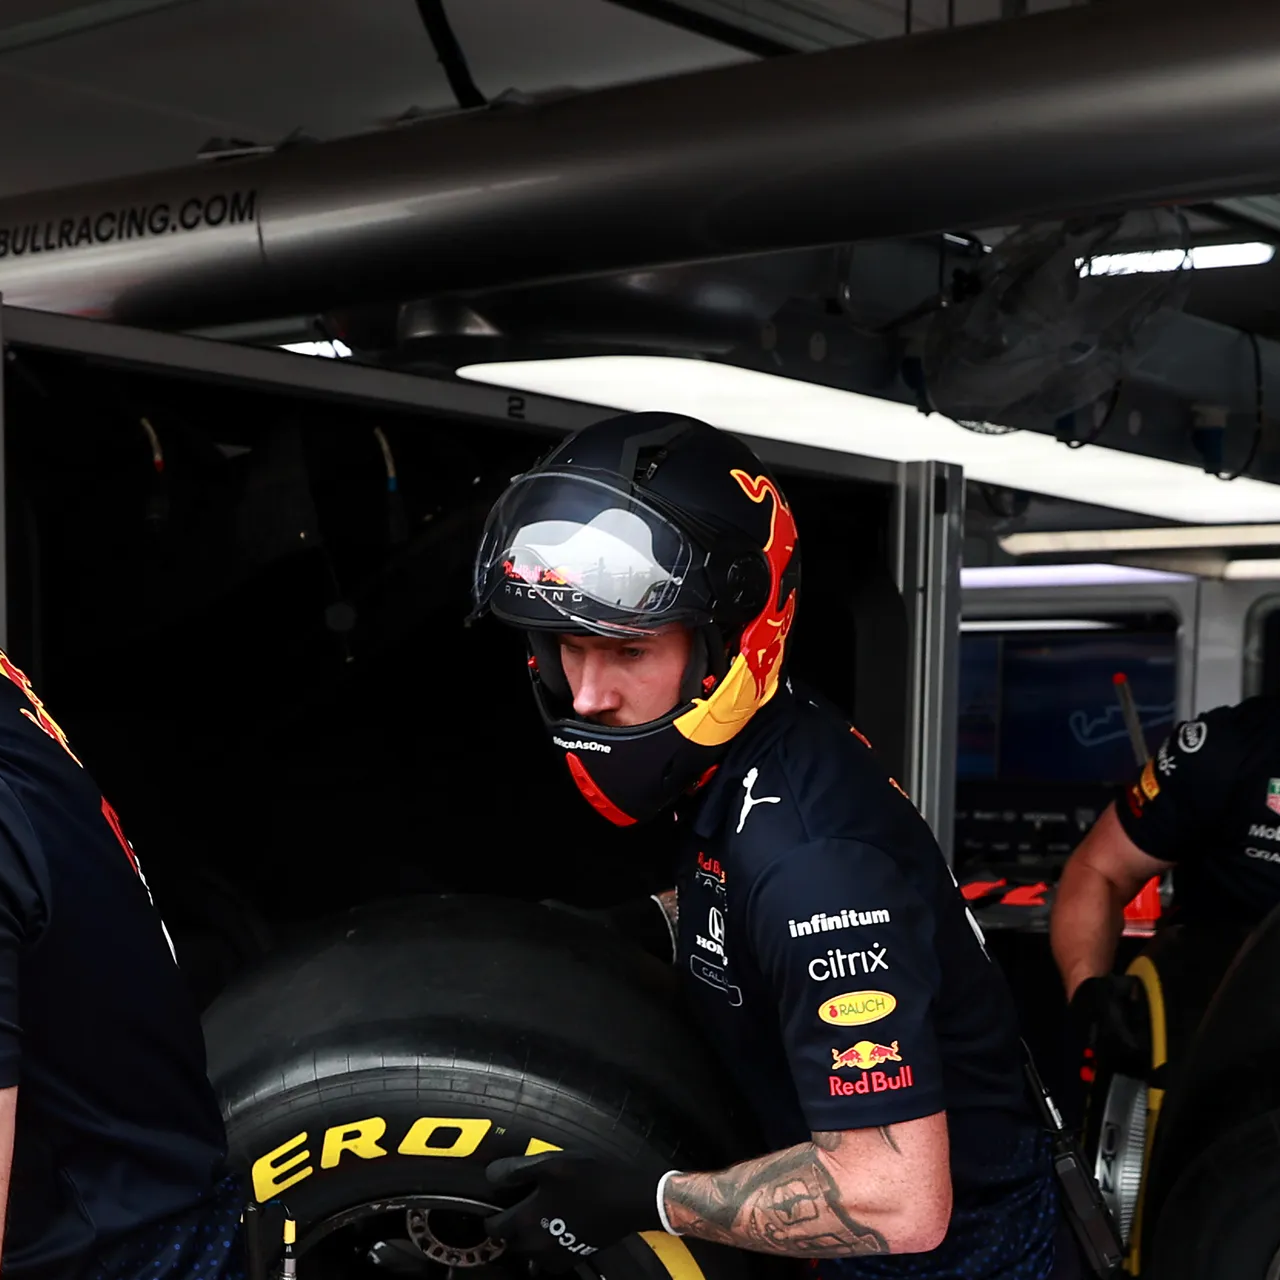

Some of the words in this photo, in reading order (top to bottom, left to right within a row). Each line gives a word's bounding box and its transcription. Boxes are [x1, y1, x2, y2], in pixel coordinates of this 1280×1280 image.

[788, 908, 890, 938] infinitum
[808, 942, 889, 981] citrix
[839, 998, 886, 1017] RAUCH
[829, 1070, 870, 1097] Red
[870, 1065, 914, 1092] Bull
